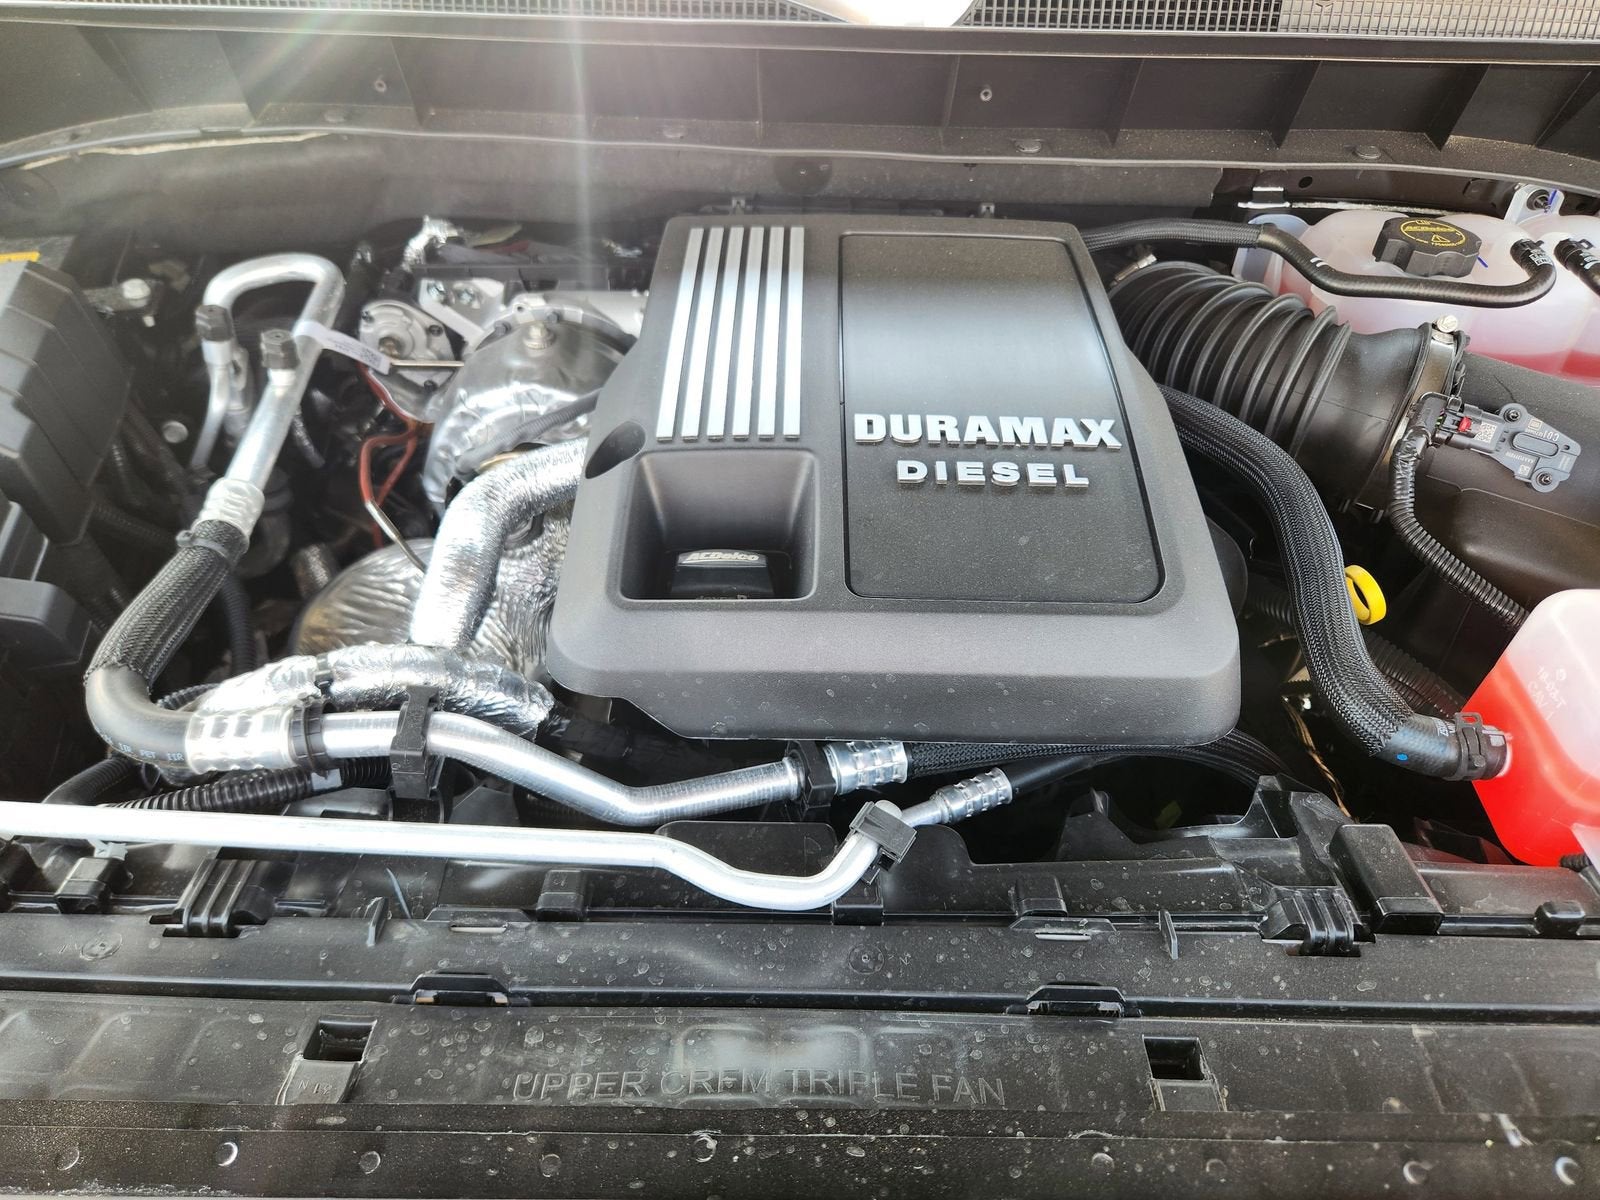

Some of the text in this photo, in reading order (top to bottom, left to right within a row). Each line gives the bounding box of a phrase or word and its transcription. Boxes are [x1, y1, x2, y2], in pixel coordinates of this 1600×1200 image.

[854, 413, 1123, 449] DURAMAX
[897, 460, 1090, 488] DIESEL
[512, 1071, 648, 1100] UPPER
[784, 1068, 921, 1102] TRIPLE
[932, 1074, 1006, 1105] FAN
